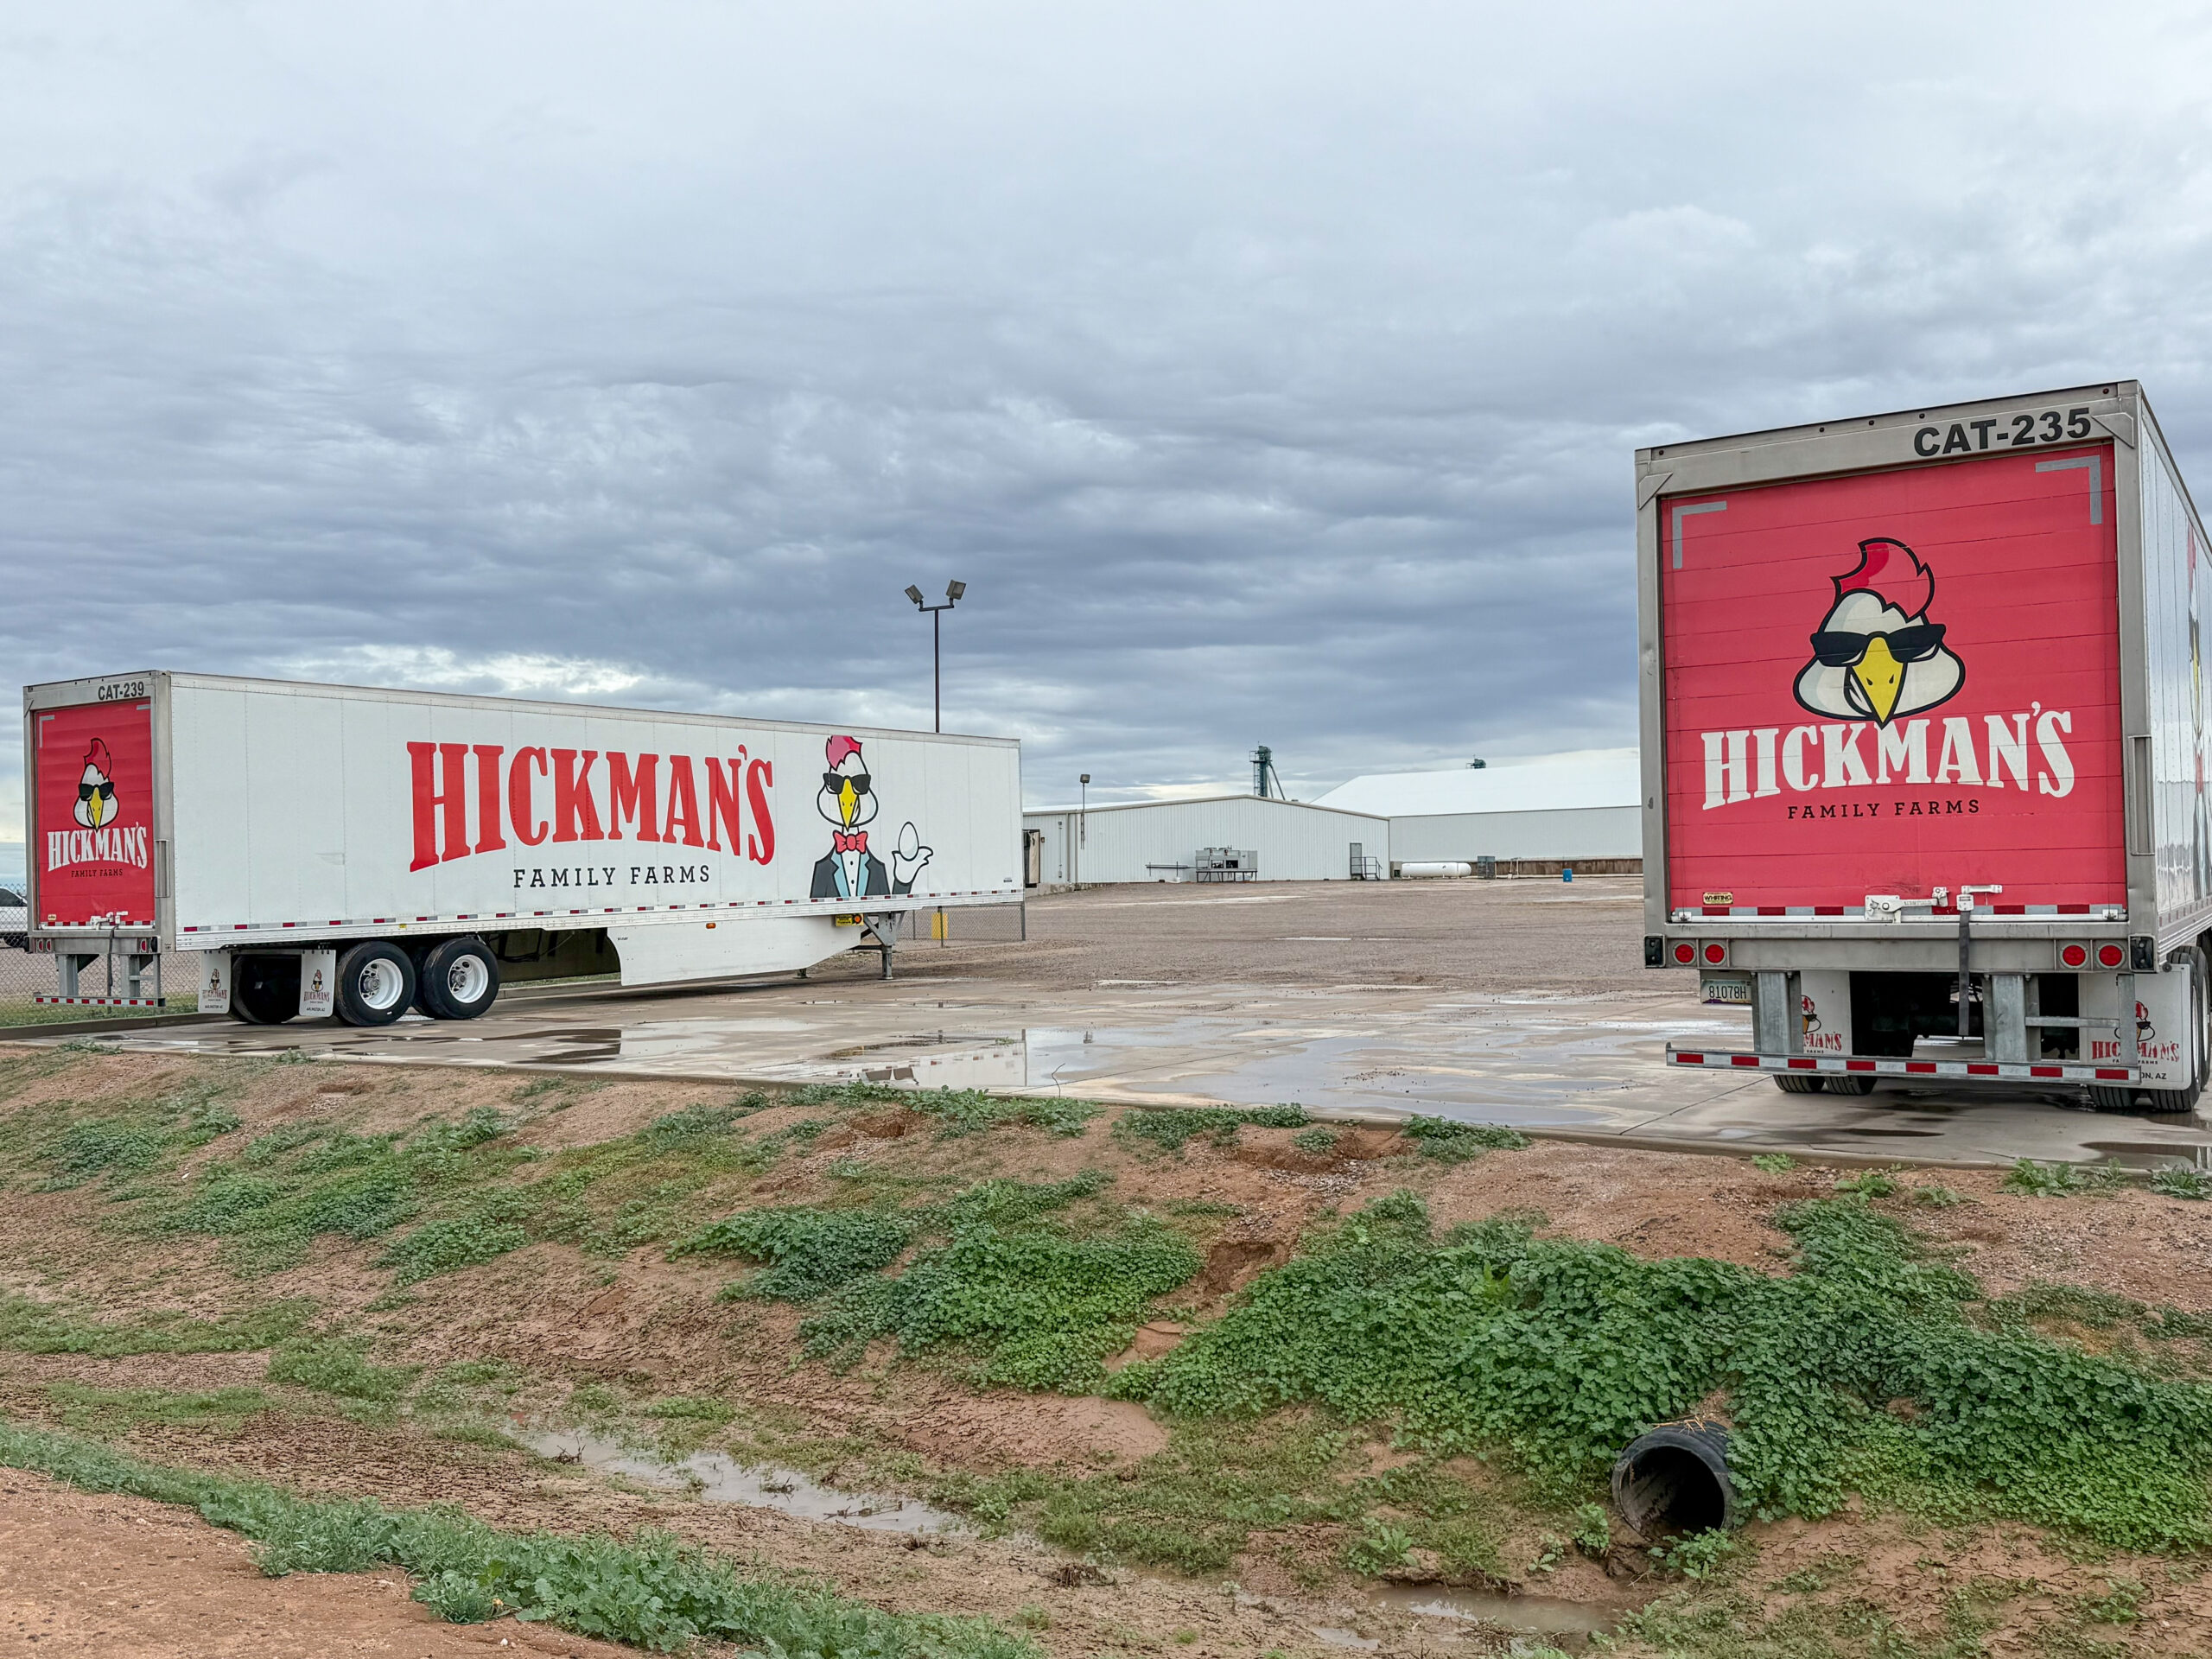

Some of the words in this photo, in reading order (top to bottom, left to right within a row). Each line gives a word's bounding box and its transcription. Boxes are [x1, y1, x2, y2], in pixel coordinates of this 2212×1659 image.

[1914, 407, 2091, 457] CAT-235
[98, 681, 144, 701] CAT-239
[1701, 702, 2075, 810] HICKMAN'S
[407, 741, 775, 873] HICKMAN'S
[1788, 804, 1880, 820] FAMILY
[1894, 799, 1980, 817] FARMS
[48, 821, 148, 872] HICKMAN'S
[71, 869, 98, 878] FAMILY
[513, 868, 617, 889] FAMILY
[630, 865, 710, 886] FARMS
[1709, 985, 1747, 1000] 81078H
[2092, 1040, 2180, 1063] HICMAN'S
